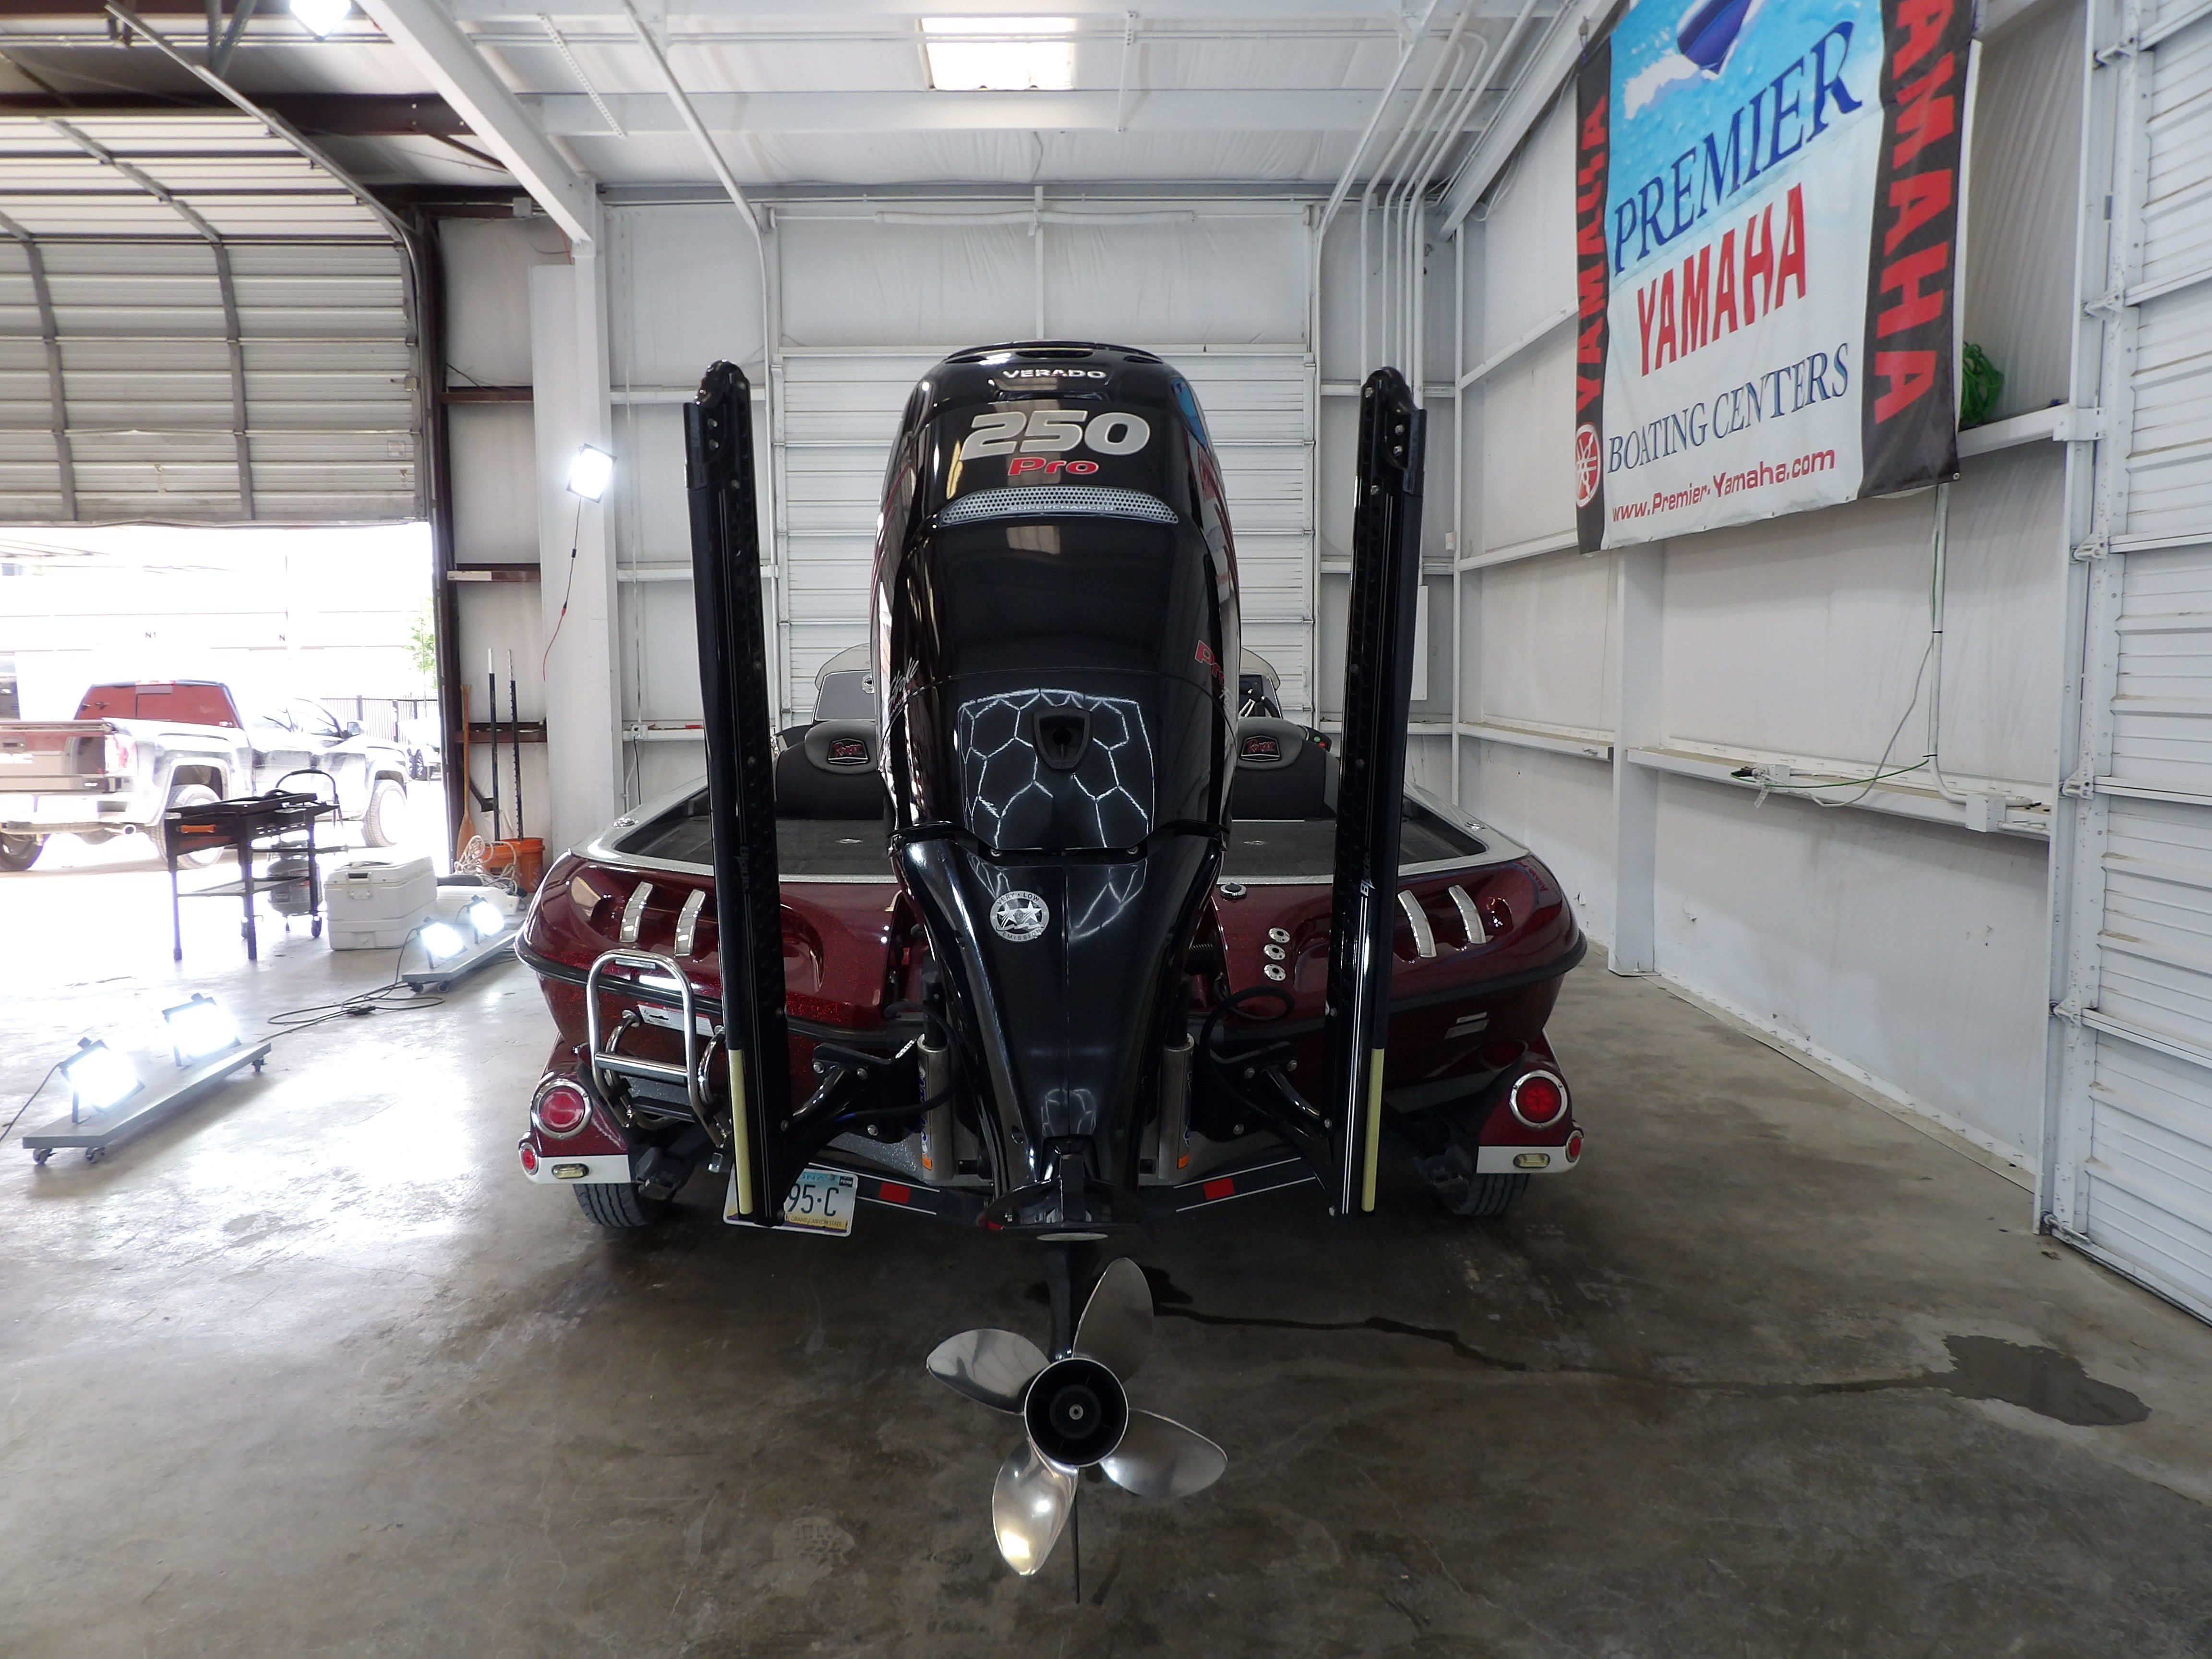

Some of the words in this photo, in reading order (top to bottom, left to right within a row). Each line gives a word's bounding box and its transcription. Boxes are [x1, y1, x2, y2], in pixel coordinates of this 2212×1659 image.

[1614, 21, 1862, 276] PREMIER
[1637, 182, 1806, 377] YAMAHA
[1003, 369, 1106, 378] VERADO
[1607, 409, 1708, 474] BOATING
[1712, 342, 1849, 440] CENTERS
[960, 409, 1151, 461] 250
[1008, 457, 1099, 476] Pro
[997, 892, 1014, 905] VERY
[1023, 892, 1040, 902] LOW
